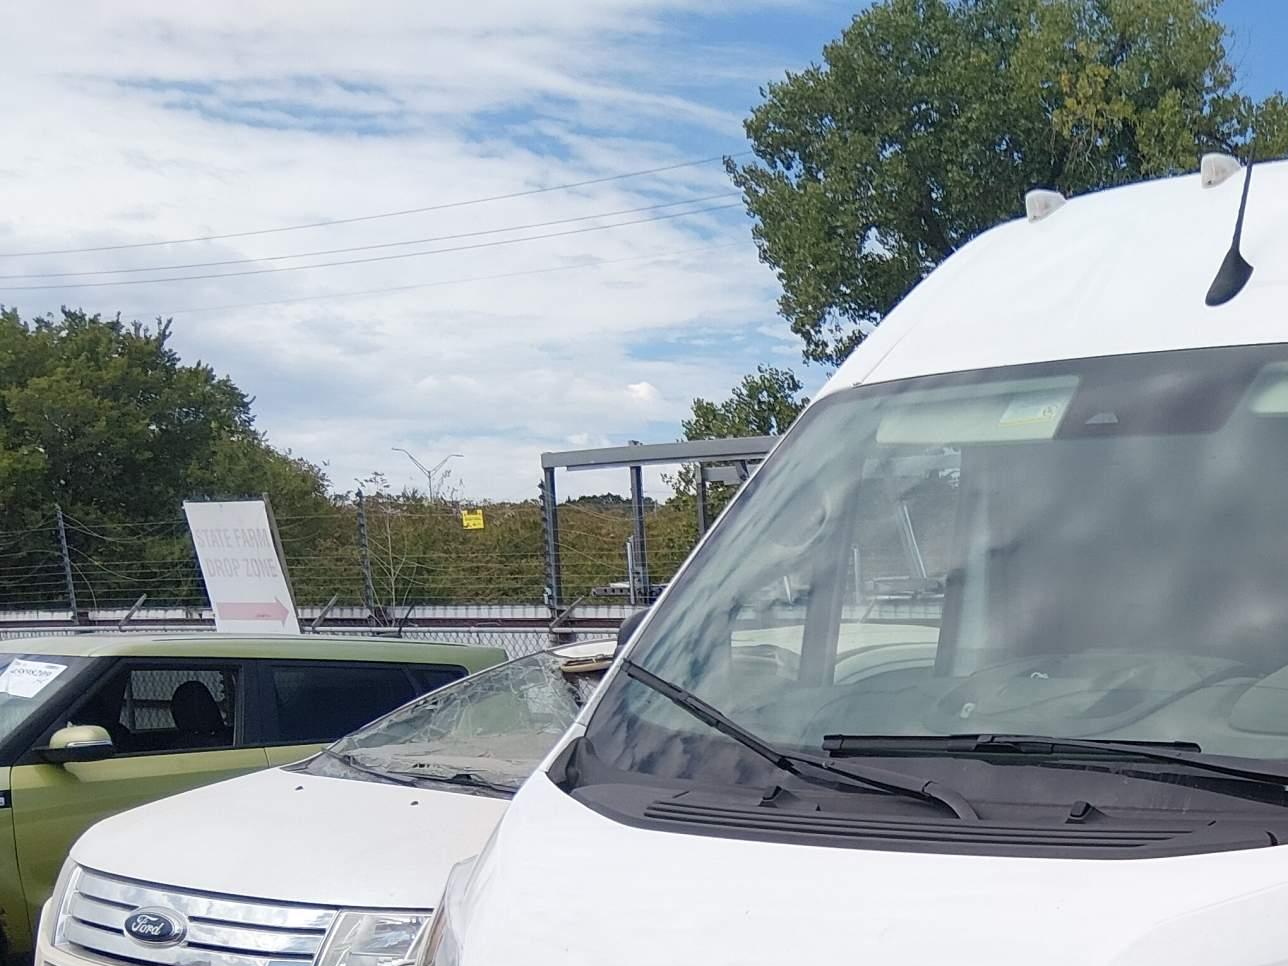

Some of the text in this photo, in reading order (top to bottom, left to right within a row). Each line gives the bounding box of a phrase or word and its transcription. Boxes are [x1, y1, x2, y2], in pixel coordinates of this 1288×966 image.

[195, 528, 271, 549] STATE FARM
[205, 558, 279, 578] DROP ZONE
[132, 914, 164, 935] Ford
